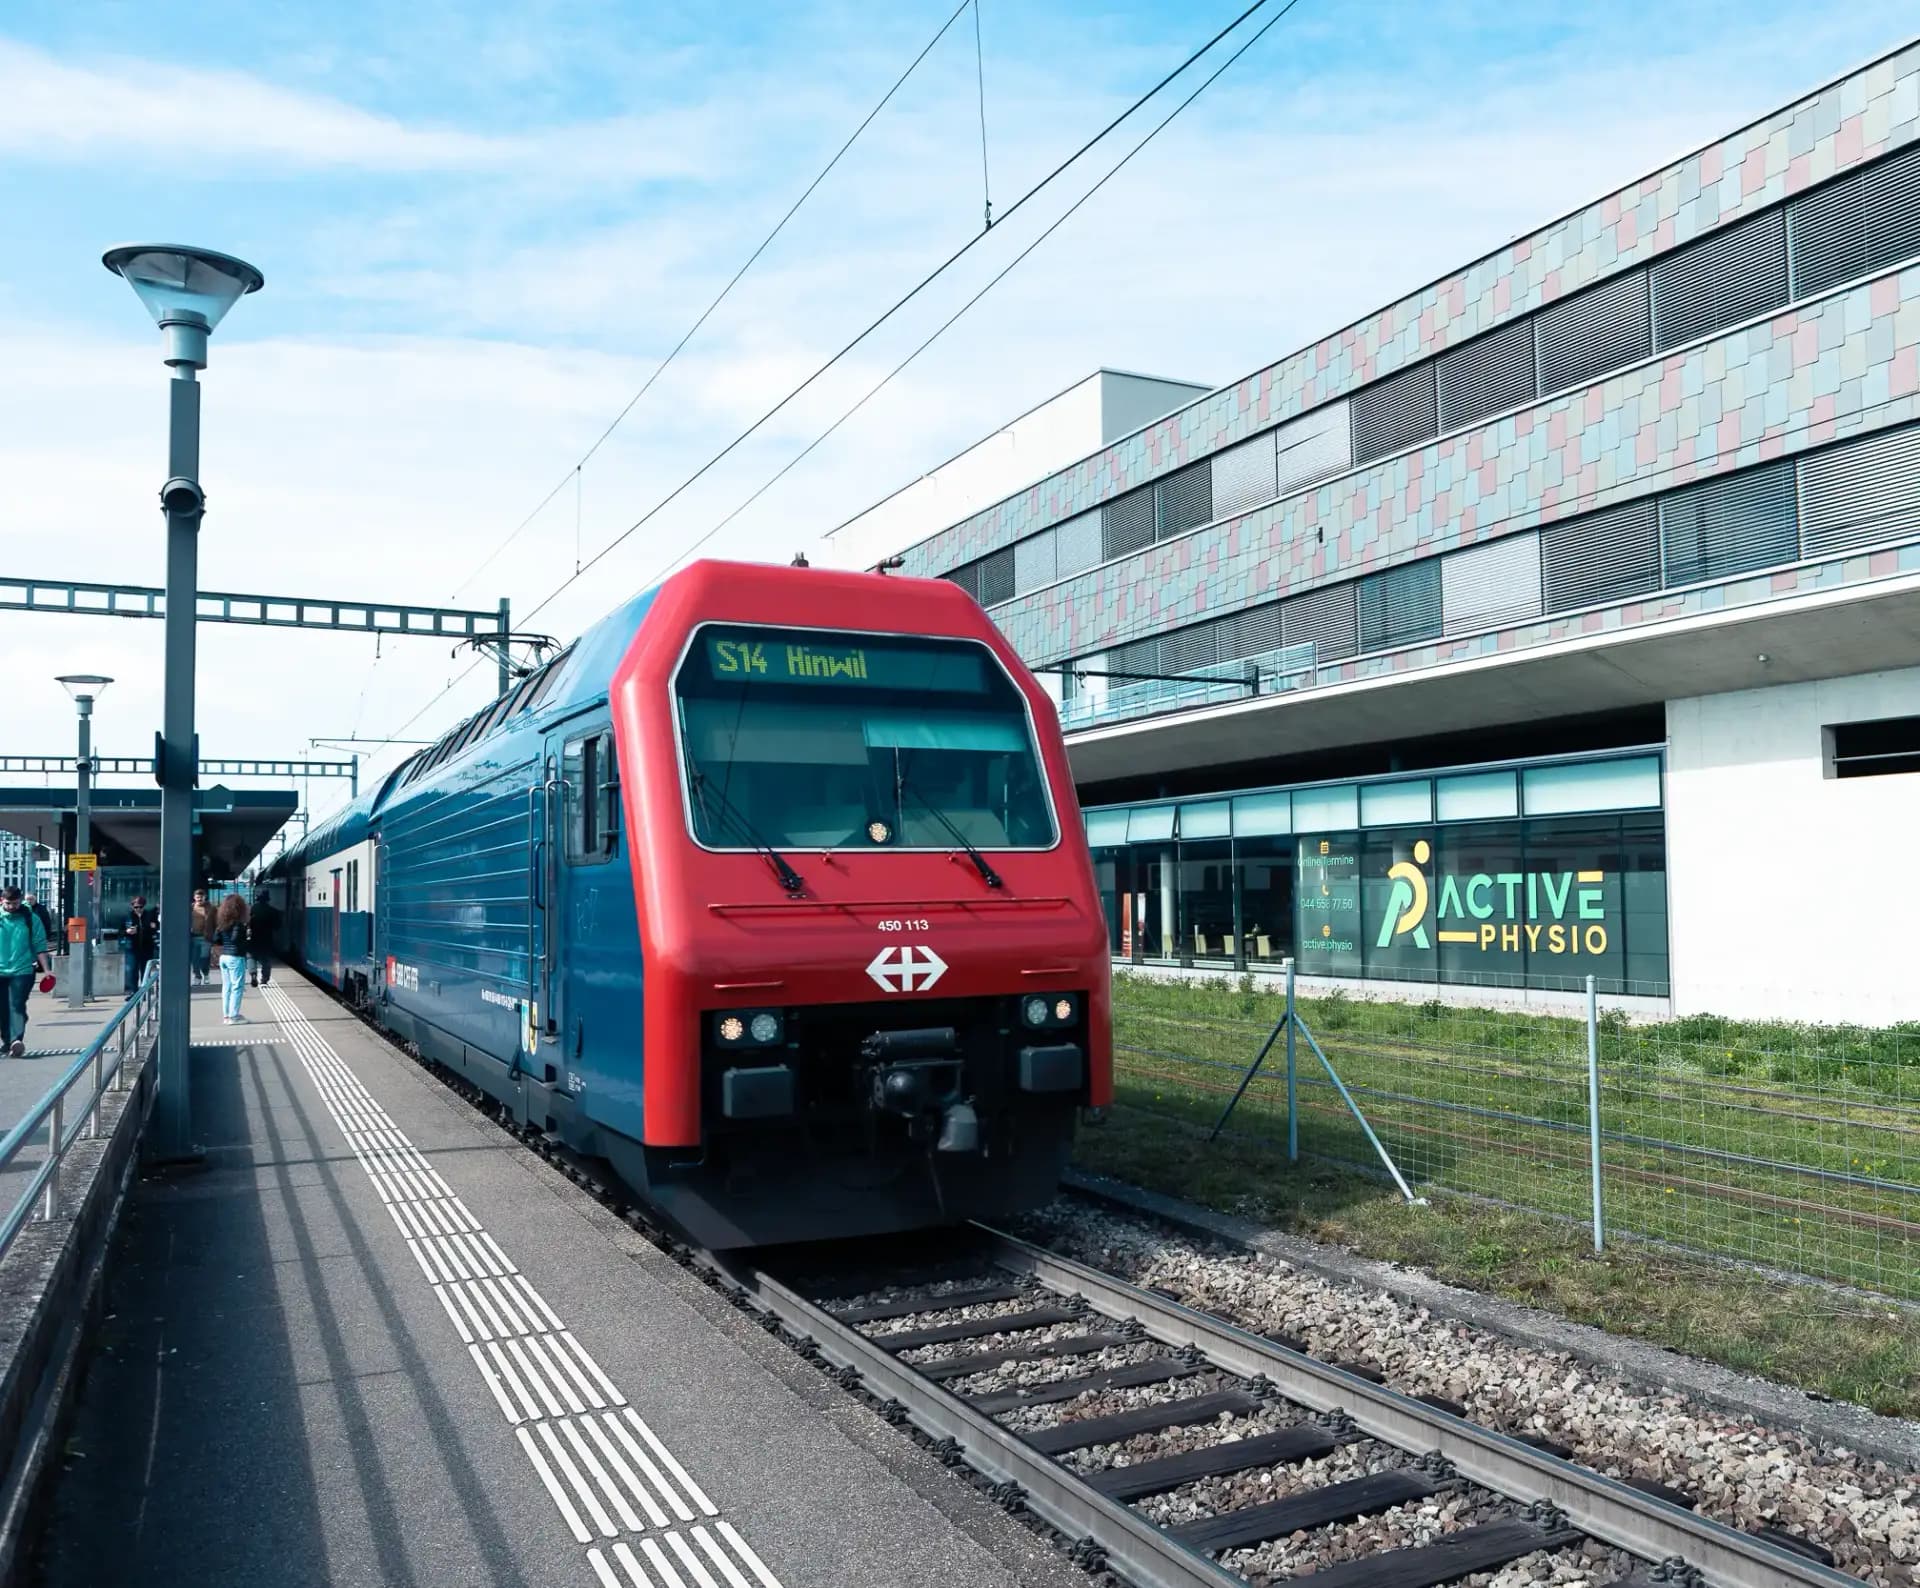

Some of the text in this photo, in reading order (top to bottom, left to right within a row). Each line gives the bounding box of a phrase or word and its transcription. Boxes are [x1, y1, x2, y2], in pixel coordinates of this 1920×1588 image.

[716, 640, 868, 679] S14 Hinwil
[1322, 854, 1354, 866] Termine
[1437, 870, 1605, 920] ACTIVE
[877, 918, 930, 932] 450 113
[1480, 924, 1608, 955] PHYSIO
